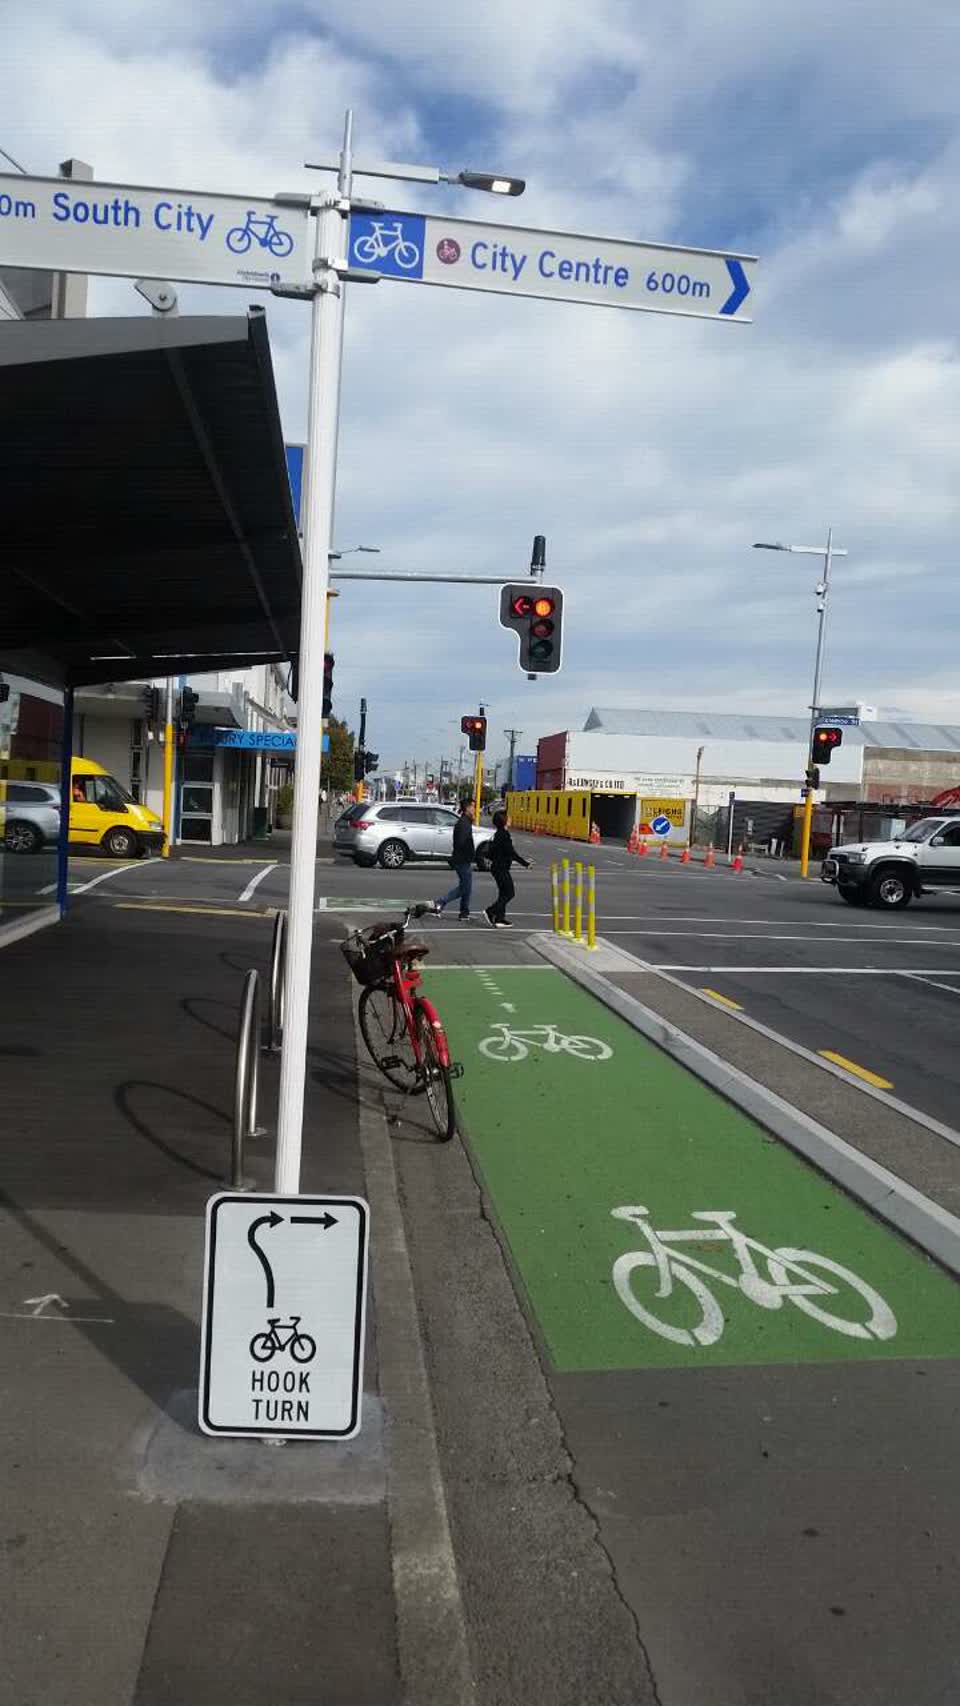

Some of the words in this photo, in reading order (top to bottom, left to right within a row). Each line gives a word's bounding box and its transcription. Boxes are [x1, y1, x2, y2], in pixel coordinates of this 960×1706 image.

[52, 192, 140, 227] South
[154, 202, 214, 240] City
[470, 241, 527, 281] City
[539, 251, 629, 288] Centre
[646, 272, 711, 299] 600m
[251, 1370, 310, 1393] HOOK
[252, 1399, 309, 1422] TURN
